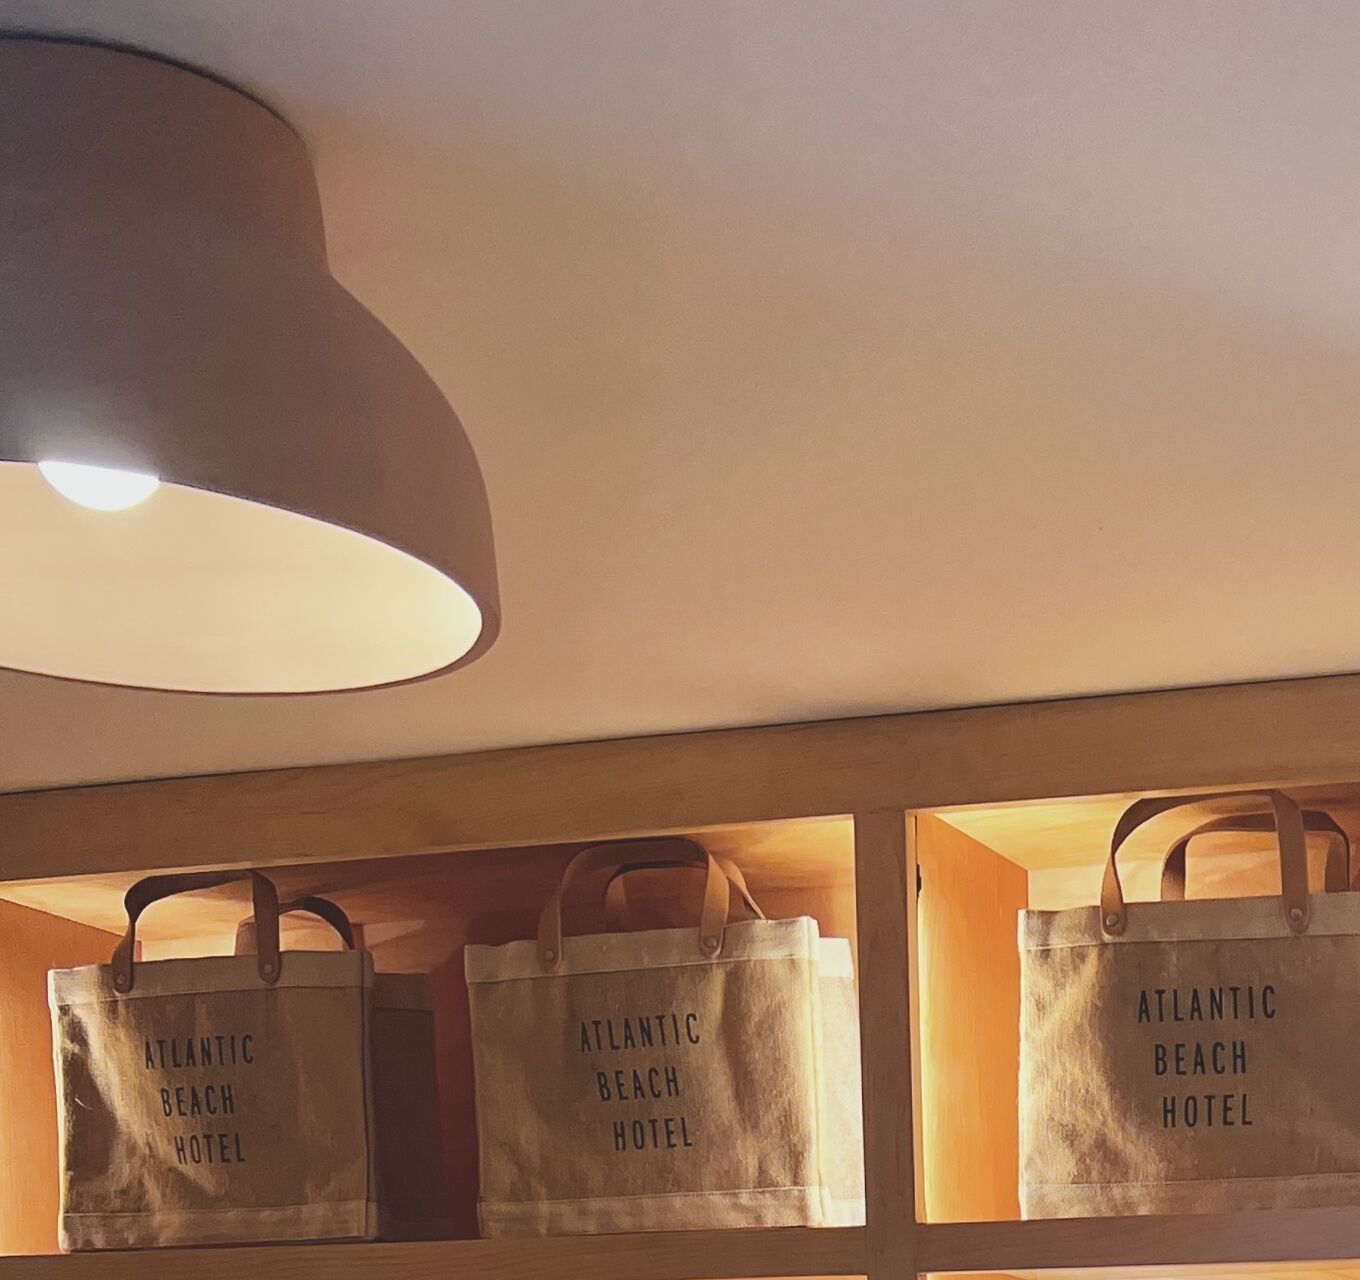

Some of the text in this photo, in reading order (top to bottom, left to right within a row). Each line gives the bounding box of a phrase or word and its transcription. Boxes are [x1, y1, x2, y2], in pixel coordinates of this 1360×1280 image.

[1137, 985, 1277, 1024] ATLANTIC
[579, 1012, 701, 1053] ATLANTIC
[144, 1034, 255, 1070] ATLANTIC
[1154, 1040, 1247, 1076] BEACH
[160, 1084, 235, 1117] BEACH
[596, 1066, 680, 1101] BEACH
[1162, 1093, 1253, 1128] HOTEL
[173, 1131, 246, 1166] HOTEL
[613, 1116, 693, 1151] HOTEL
